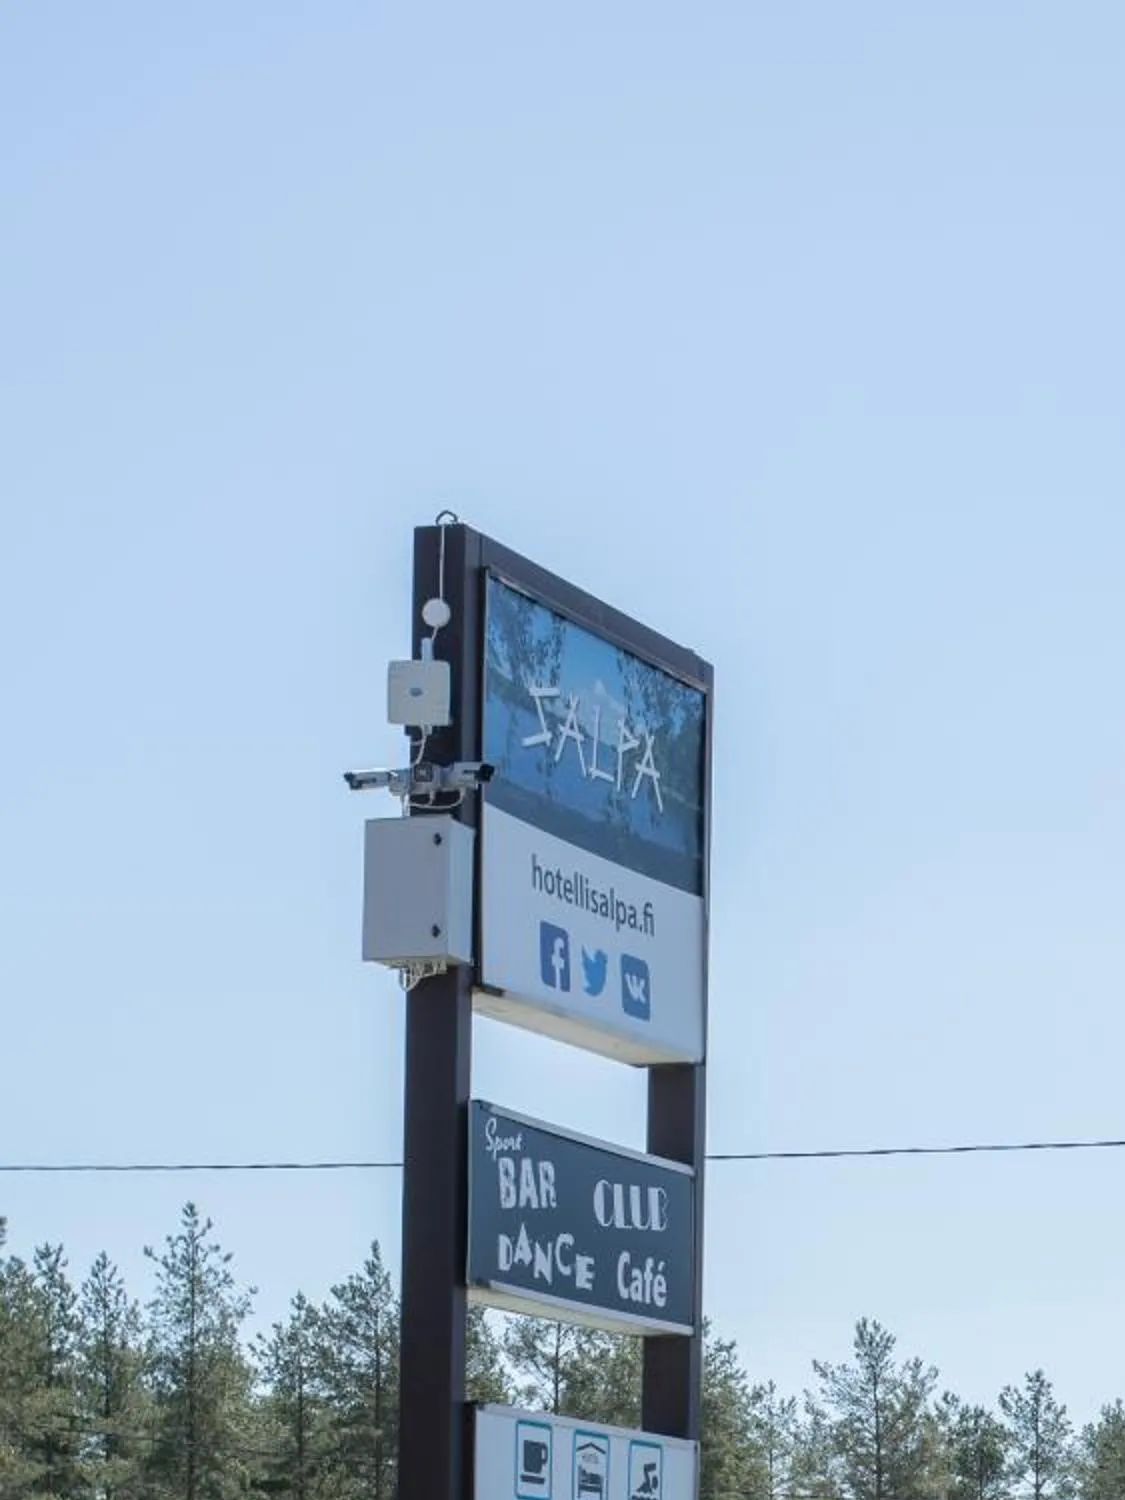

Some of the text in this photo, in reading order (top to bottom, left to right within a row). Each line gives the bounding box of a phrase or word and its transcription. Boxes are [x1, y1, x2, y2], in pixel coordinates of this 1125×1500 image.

[522, 686, 664, 813] SALPA
[531, 854, 655, 936] hotellisalpa.fi
[485, 1117, 523, 1161] Sport
[498, 1157, 669, 1232] BAR CLUB
[498, 1223, 667, 1308] DANCE Café
